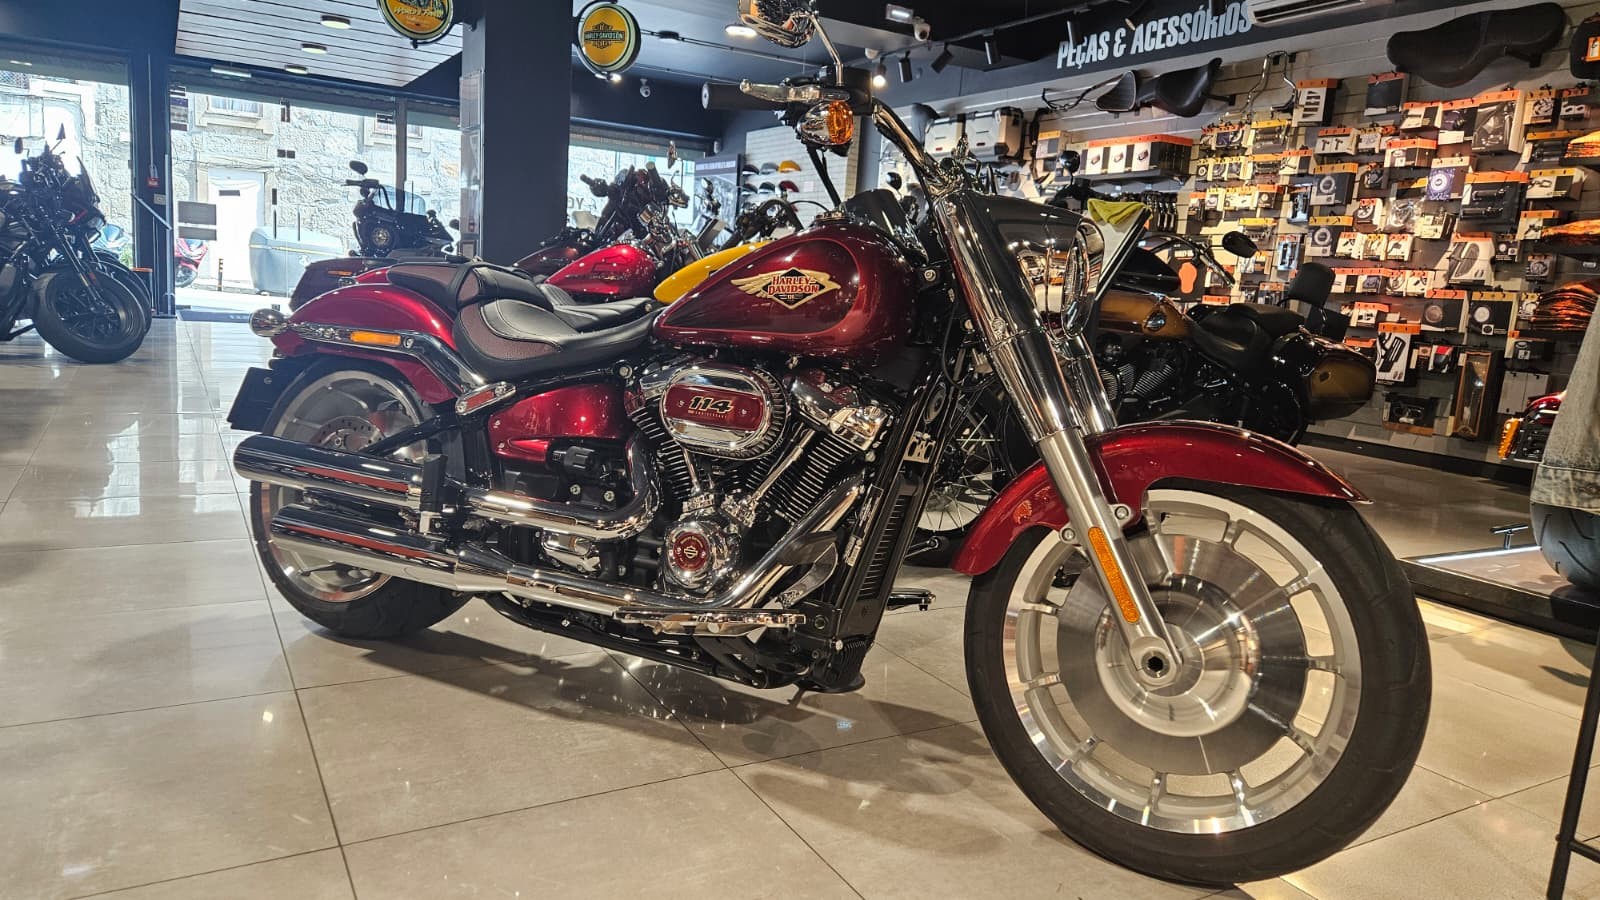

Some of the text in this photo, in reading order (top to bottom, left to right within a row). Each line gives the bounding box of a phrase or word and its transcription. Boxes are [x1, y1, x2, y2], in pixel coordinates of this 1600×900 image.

[1113, 27, 1127, 58] &
[772, 276, 816, 285] HARLEY-
[768, 285, 819, 295] DAVIDSON
[688, 396, 734, 414] 114
